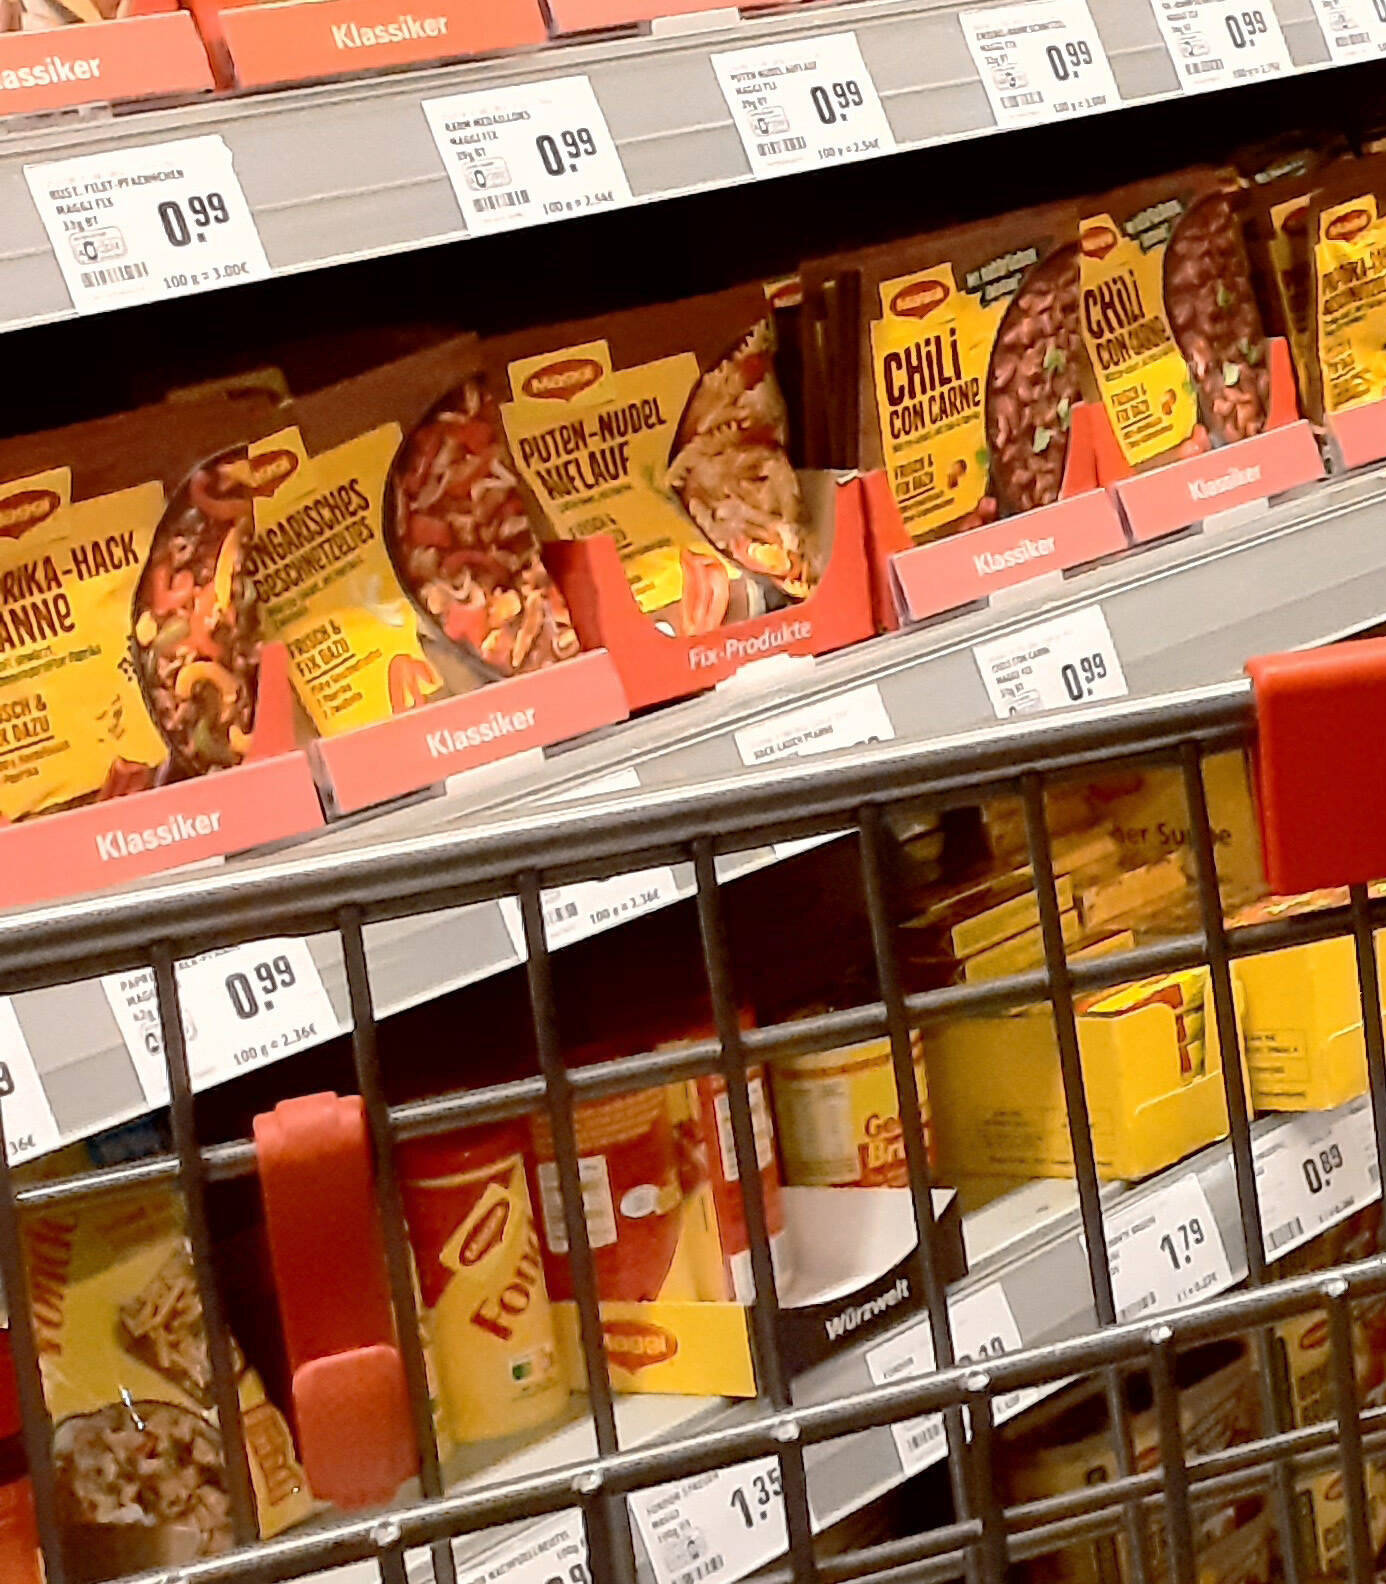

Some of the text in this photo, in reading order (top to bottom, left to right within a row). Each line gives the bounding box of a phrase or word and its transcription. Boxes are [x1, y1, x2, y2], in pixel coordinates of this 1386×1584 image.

[331, 16, 447, 49] Klassiker
[1225, 11, 1267, 48] 0.99
[1046, 41, 1092, 81] 0.99
[810, 81, 863, 124] 0.99
[536, 128, 597, 176] 0.99
[158, 193, 229, 246] 0.99
[163, 274, 187, 289] 100
[1082, 268, 1146, 340] CHILI
[883, 326, 961, 408] CHILI
[1095, 338, 1127, 371] CON
[519, 396, 667, 468] PUTEN-NUDEL
[889, 377, 981, 440] CON CARNE
[1187, 463, 1259, 500] Klassiker
[0, 530, 140, 608] RIKA-HACK
[973, 537, 1055, 574] Klassiker
[689, 622, 811, 671] Fix-Produkte
[1062, 653, 1107, 701] 0.99
[426, 707, 535, 758] Klassiker
[97, 811, 220, 861] Klassiker
[1157, 818, 1232, 848] Sue
[225, 954, 295, 1019] 0.99
[234, 1049, 258, 1066] 100
[283, 1026, 318, 1048] 2.36€
[1303, 1144, 1342, 1194] 0.89
[1160, 1214, 1206, 1273] 1.79
[824, 1277, 909, 1342] Würzwelt
